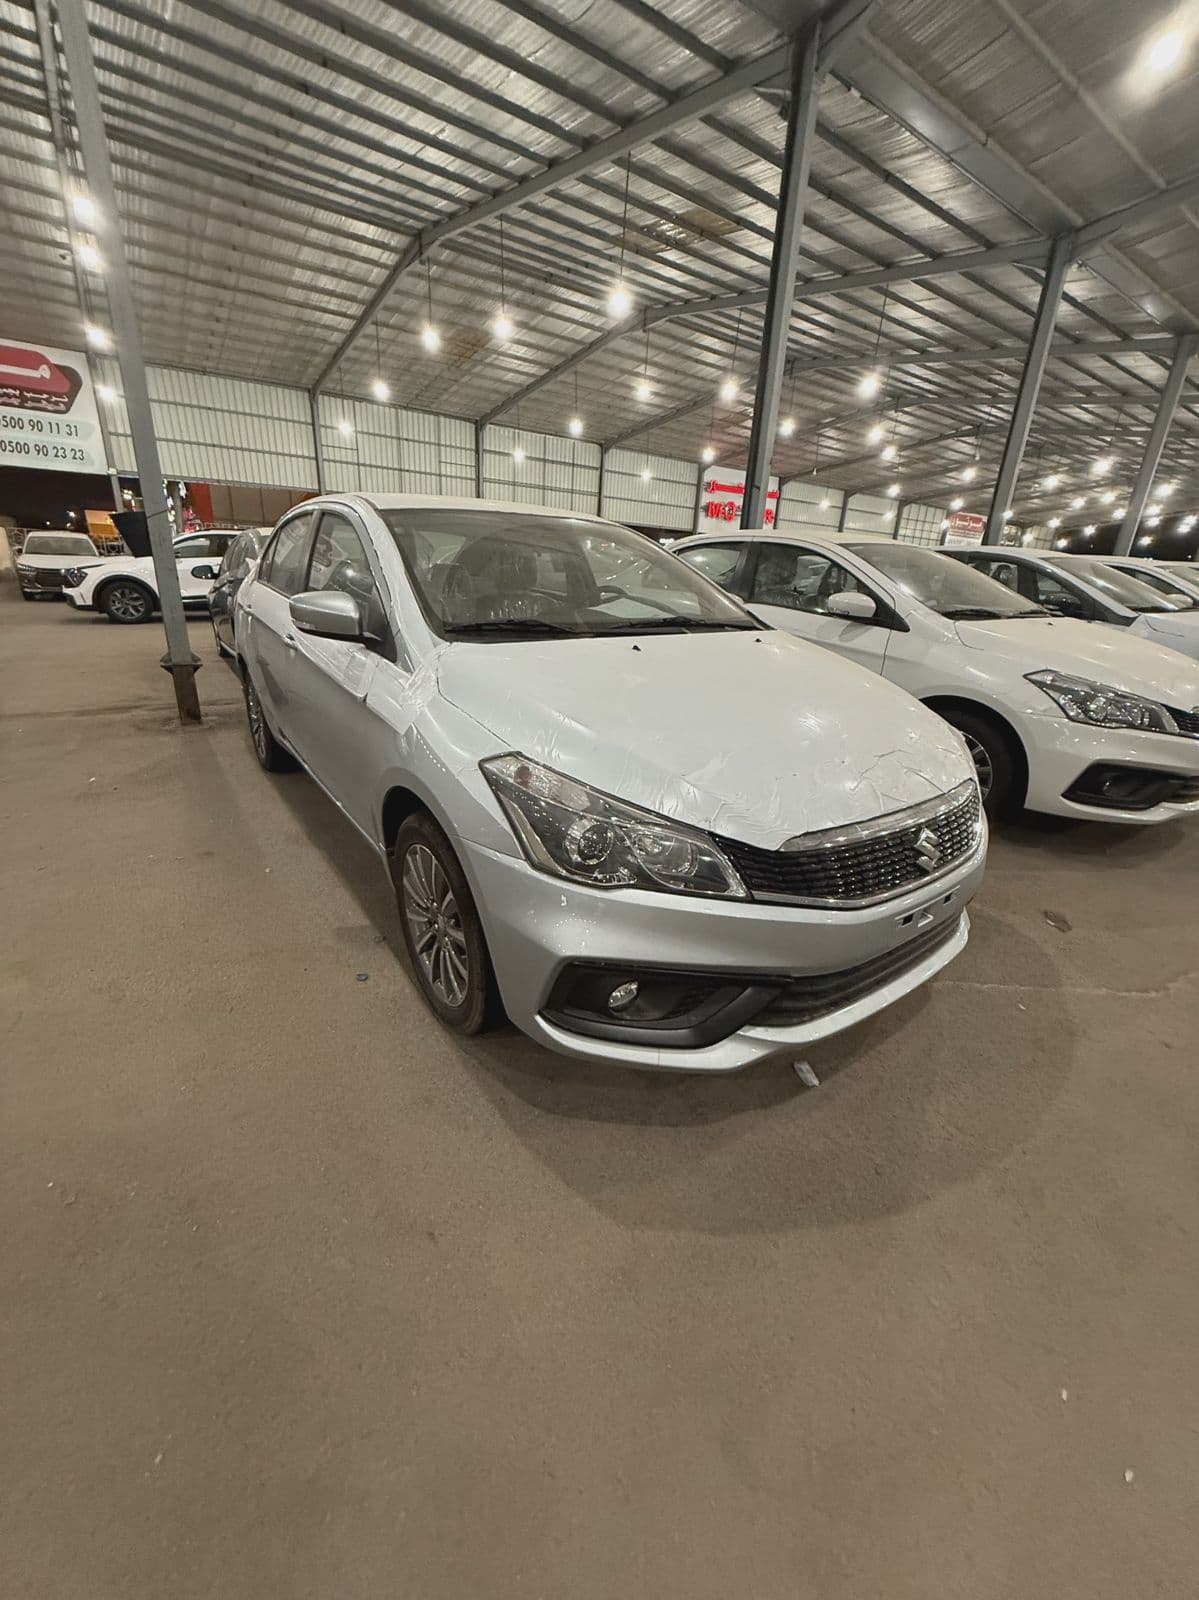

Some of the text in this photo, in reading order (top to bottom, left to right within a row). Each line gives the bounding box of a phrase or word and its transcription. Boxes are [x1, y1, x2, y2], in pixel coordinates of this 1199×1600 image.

[0, 415, 78, 437] 500 90 11 31
[0, 440, 85, 461] 0500 90 23 23
